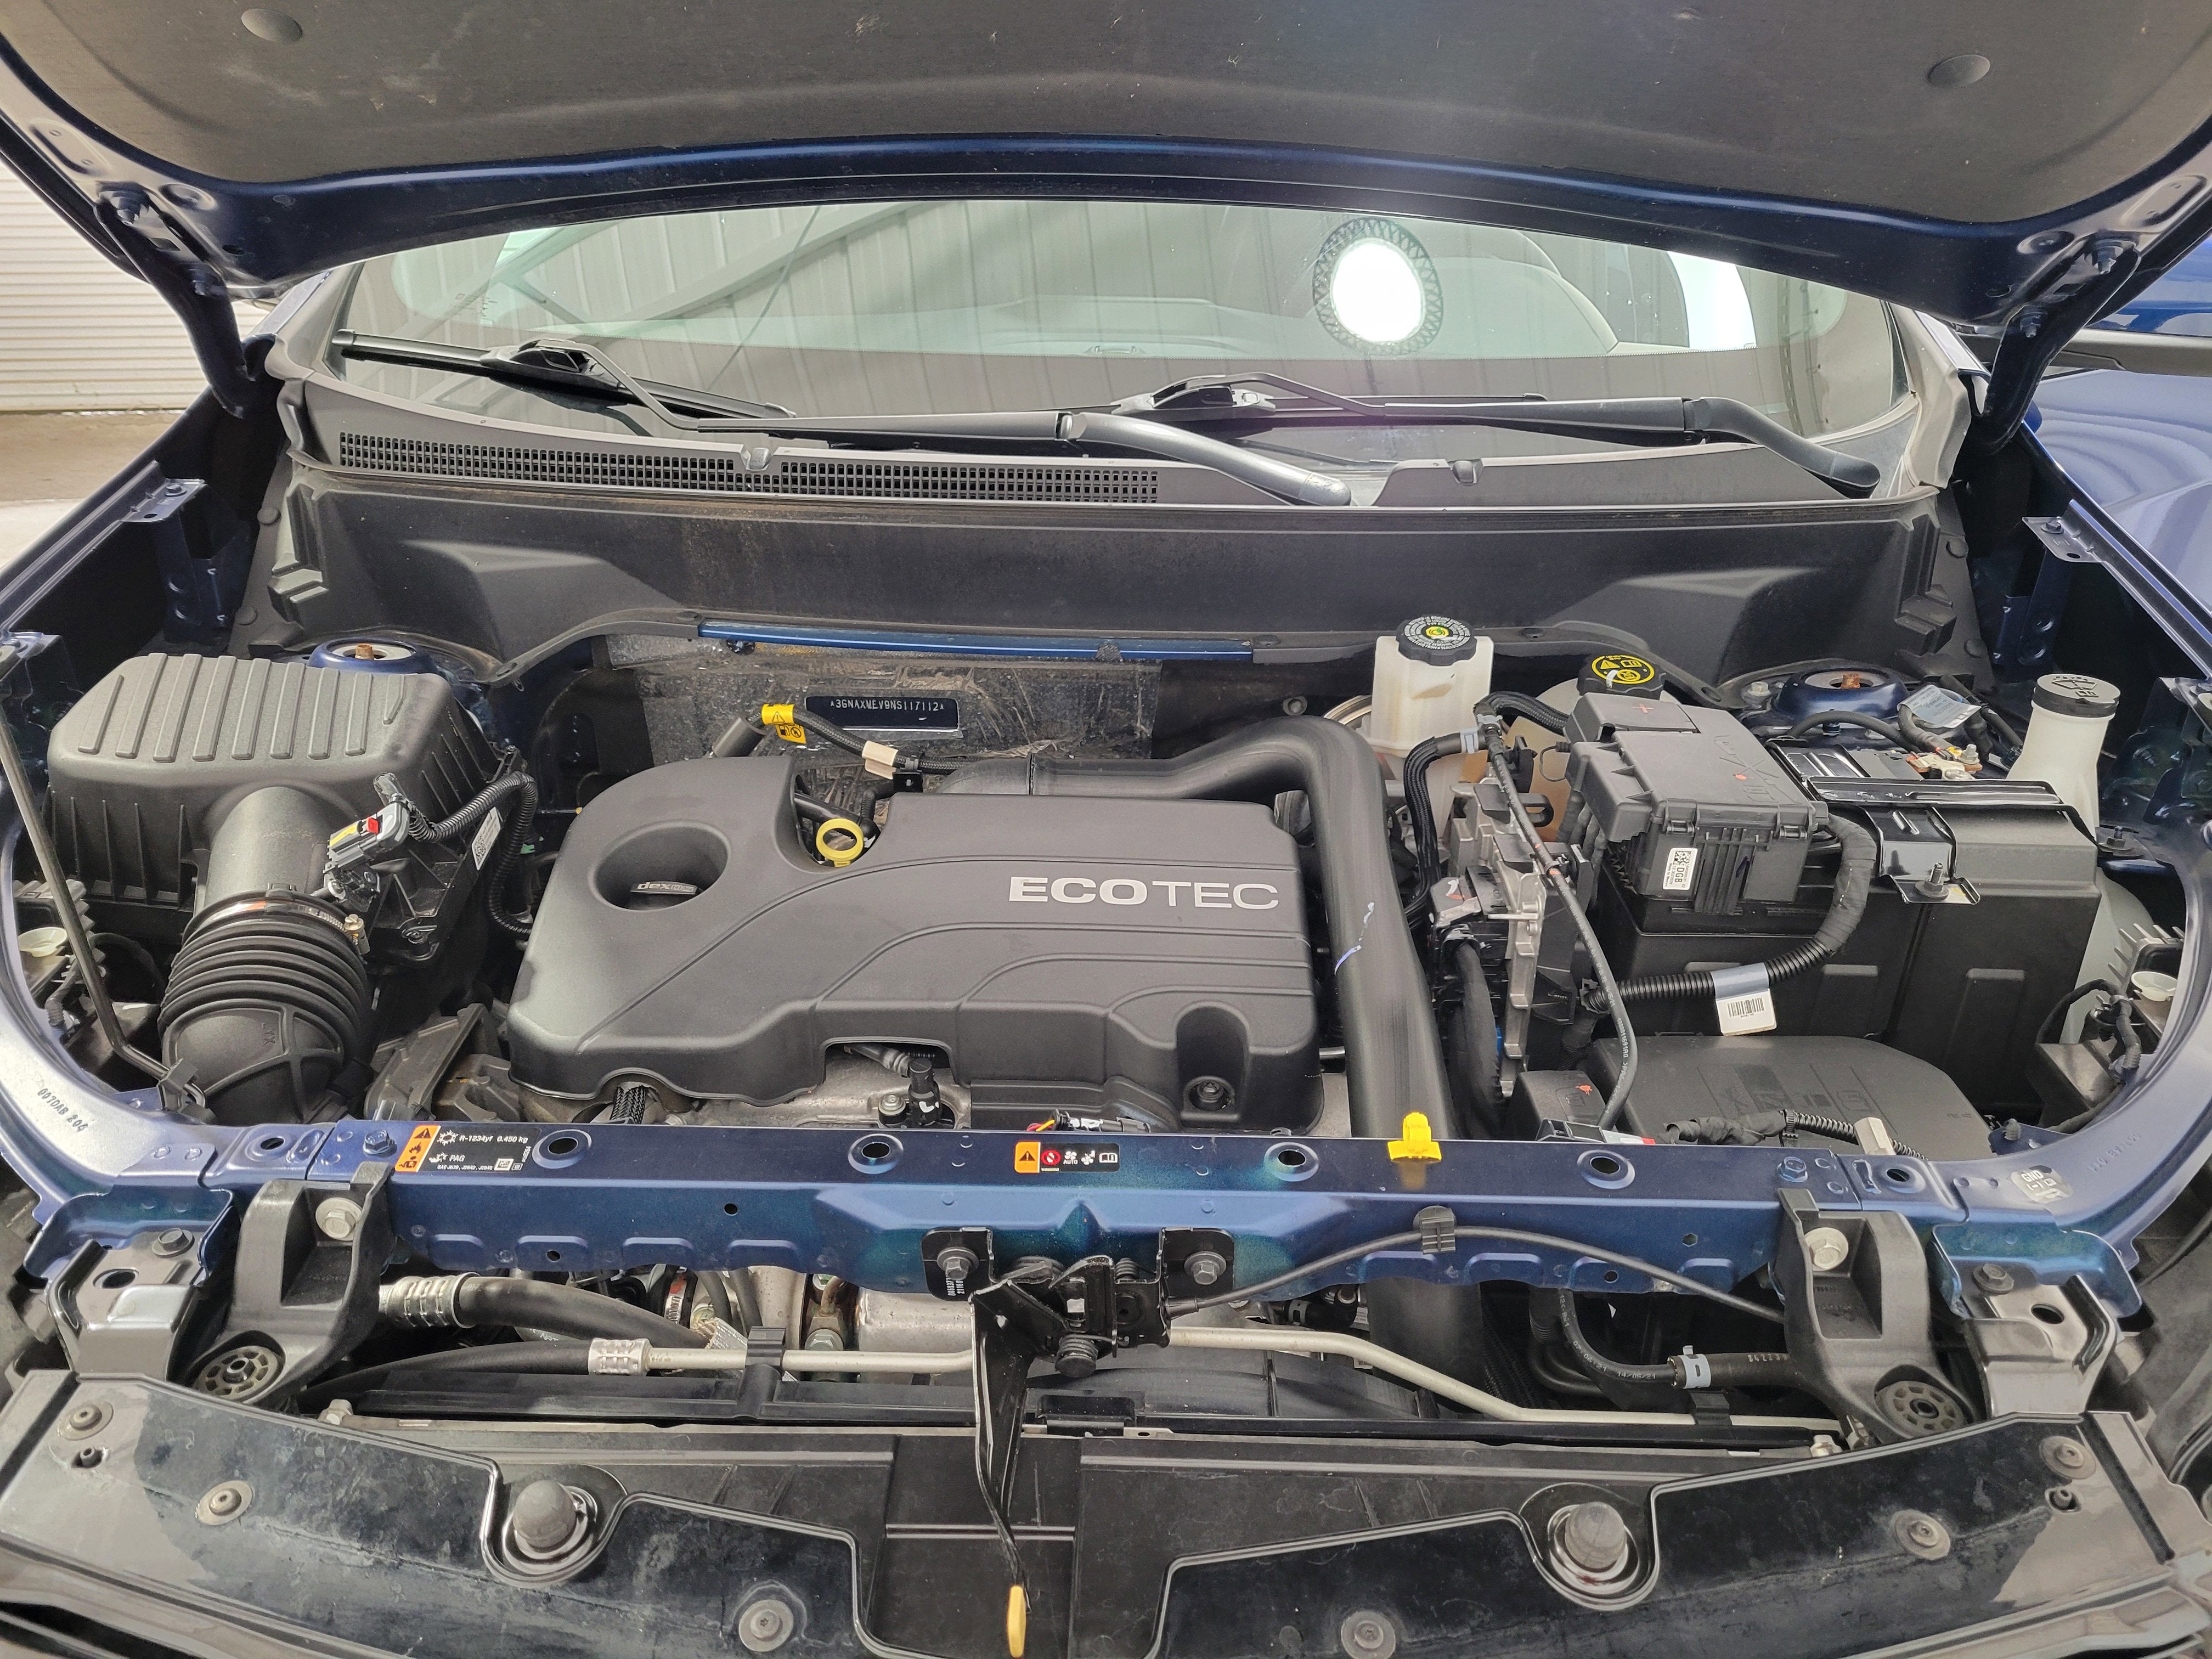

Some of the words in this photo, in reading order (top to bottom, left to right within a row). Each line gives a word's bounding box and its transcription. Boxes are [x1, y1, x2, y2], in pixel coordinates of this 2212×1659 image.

[1674, 867, 1685, 883] DGB
[637, 882, 695, 893] dexos
[1008, 876, 1279, 910] ECOTEC
[459, 1135, 494, 1143] R-1234yf
[518, 1136, 528, 1144] kg
[449, 1154, 465, 1163] PAG
[2021, 1170, 2044, 1182] GND
